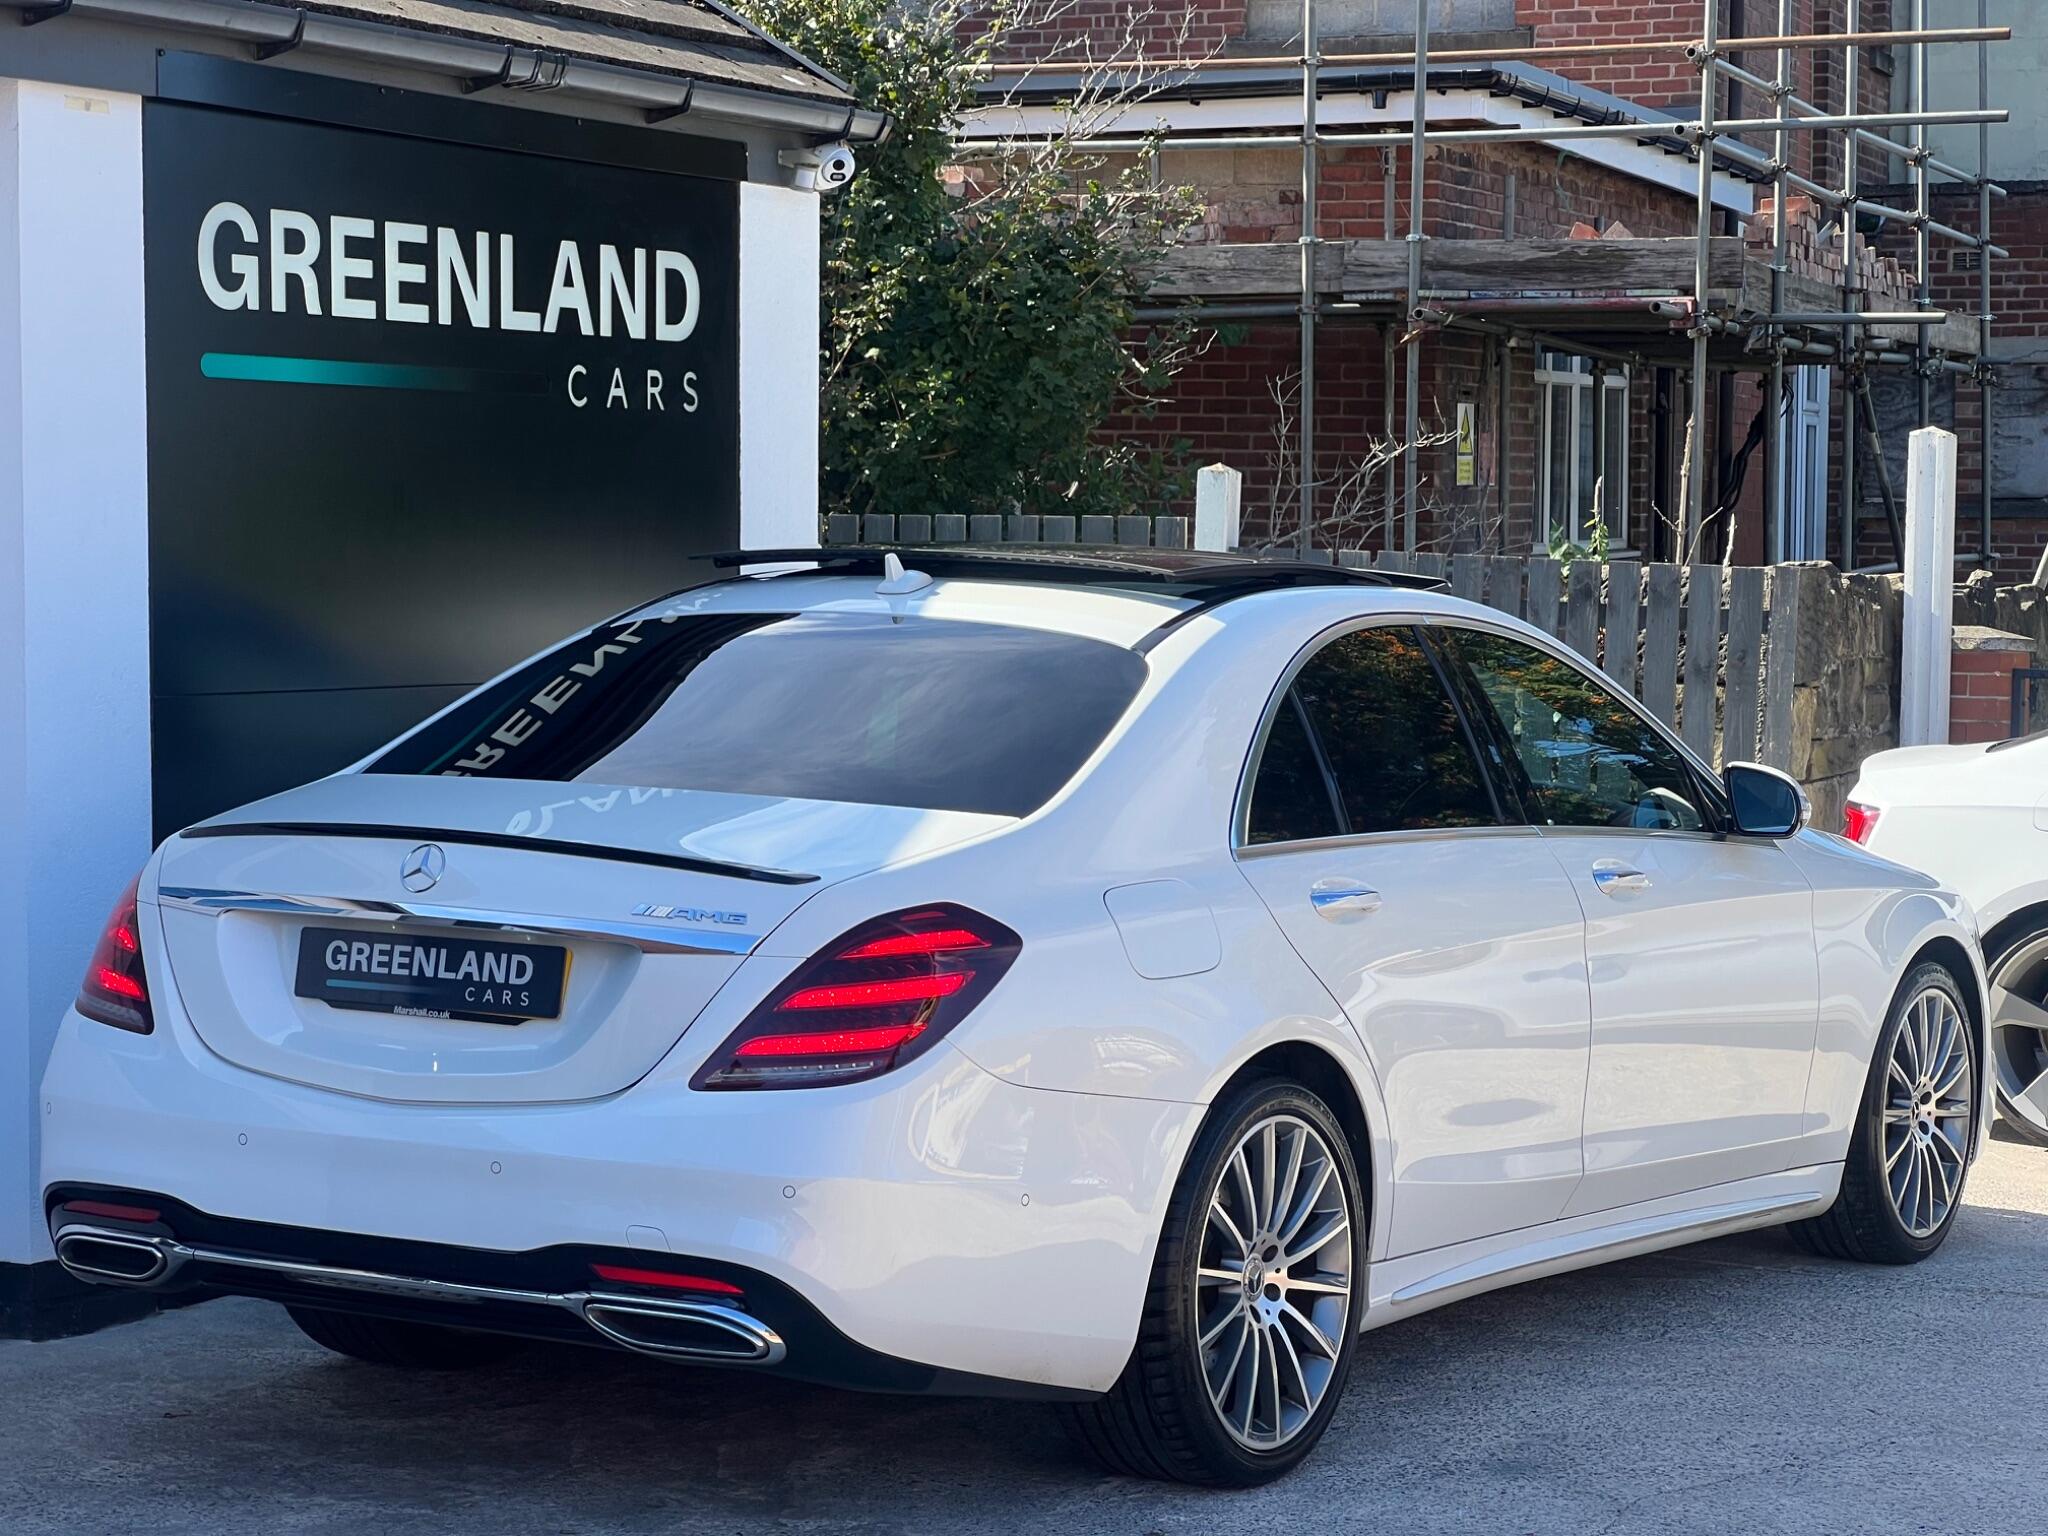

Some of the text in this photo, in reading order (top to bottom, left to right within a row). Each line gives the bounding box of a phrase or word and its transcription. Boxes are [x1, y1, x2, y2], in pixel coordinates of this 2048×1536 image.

[198, 201, 701, 343] GREENLAND
[566, 364, 699, 413] CARS
[325, 939, 534, 986] GREENLAND
[393, 1005, 451, 1019] Marshall.co.uk
[464, 986, 530, 1007] CARS
